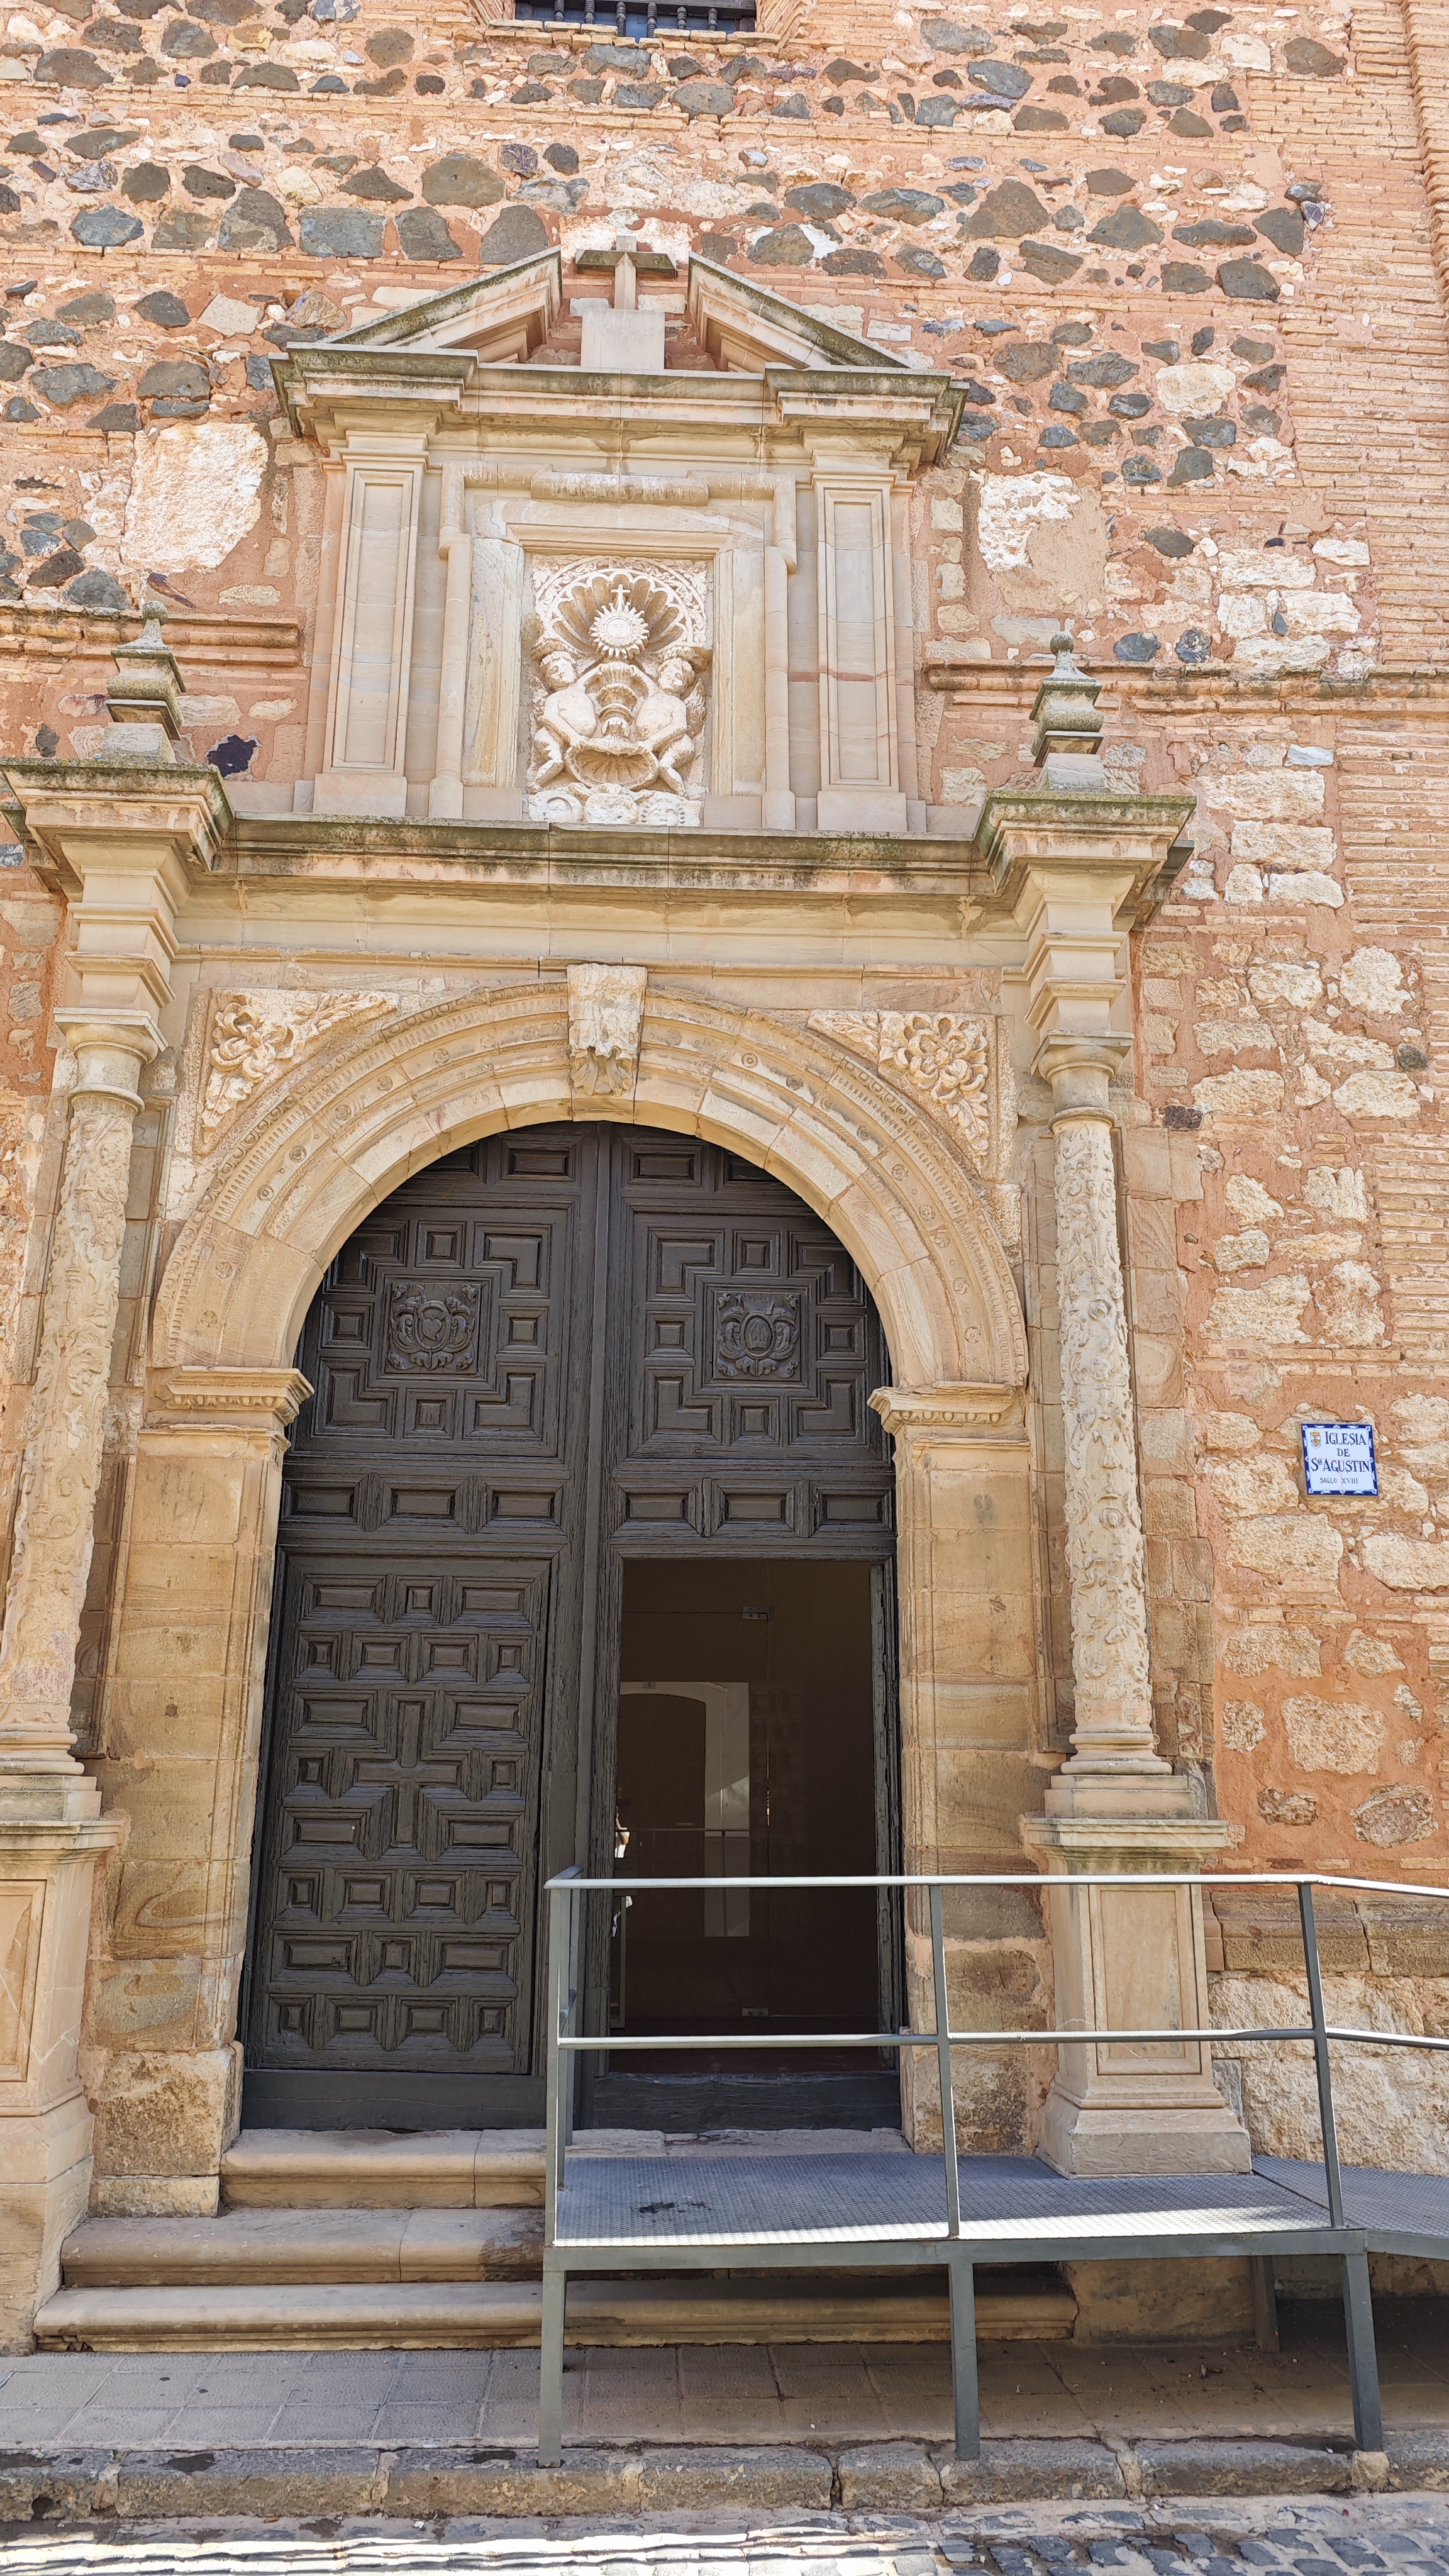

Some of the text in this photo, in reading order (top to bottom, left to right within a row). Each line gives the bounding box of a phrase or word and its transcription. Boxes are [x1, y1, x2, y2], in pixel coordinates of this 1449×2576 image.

[1324, 1431, 1367, 1446] IGLESIA
[1336, 1448, 1351, 1457] DE
[1322, 1458, 1370, 1474] AGUSTIN
